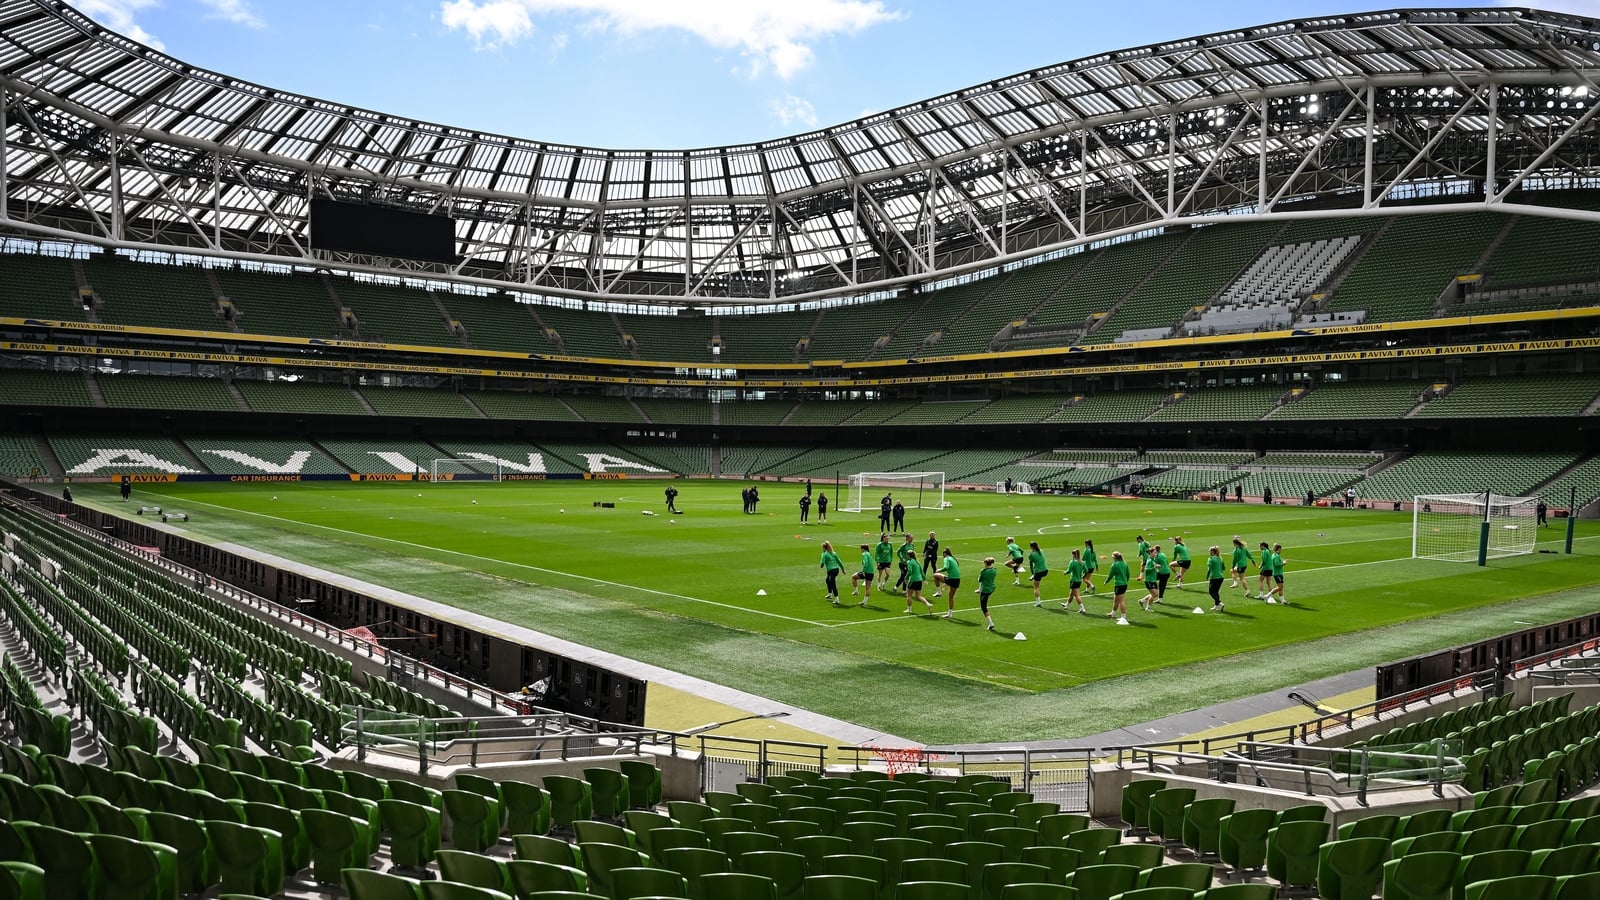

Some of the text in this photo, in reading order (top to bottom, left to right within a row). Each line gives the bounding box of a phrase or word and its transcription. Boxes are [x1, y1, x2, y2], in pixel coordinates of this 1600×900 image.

[66, 322, 126, 332] AVIVA STADIUM
[1327, 324, 1384, 335] AVIVA STADIUM
[18, 342, 47, 350] AVIVA
[66, 345, 93, 353] AVIVA
[1485, 344, 1515, 352] AVIVA
[103, 347, 130, 356] AVIVA
[140, 350, 167, 358] AVIVA
[177, 352, 201, 360] AVIVA
[211, 354, 236, 362] AVIVA
[66, 449, 669, 474] AVIVA
